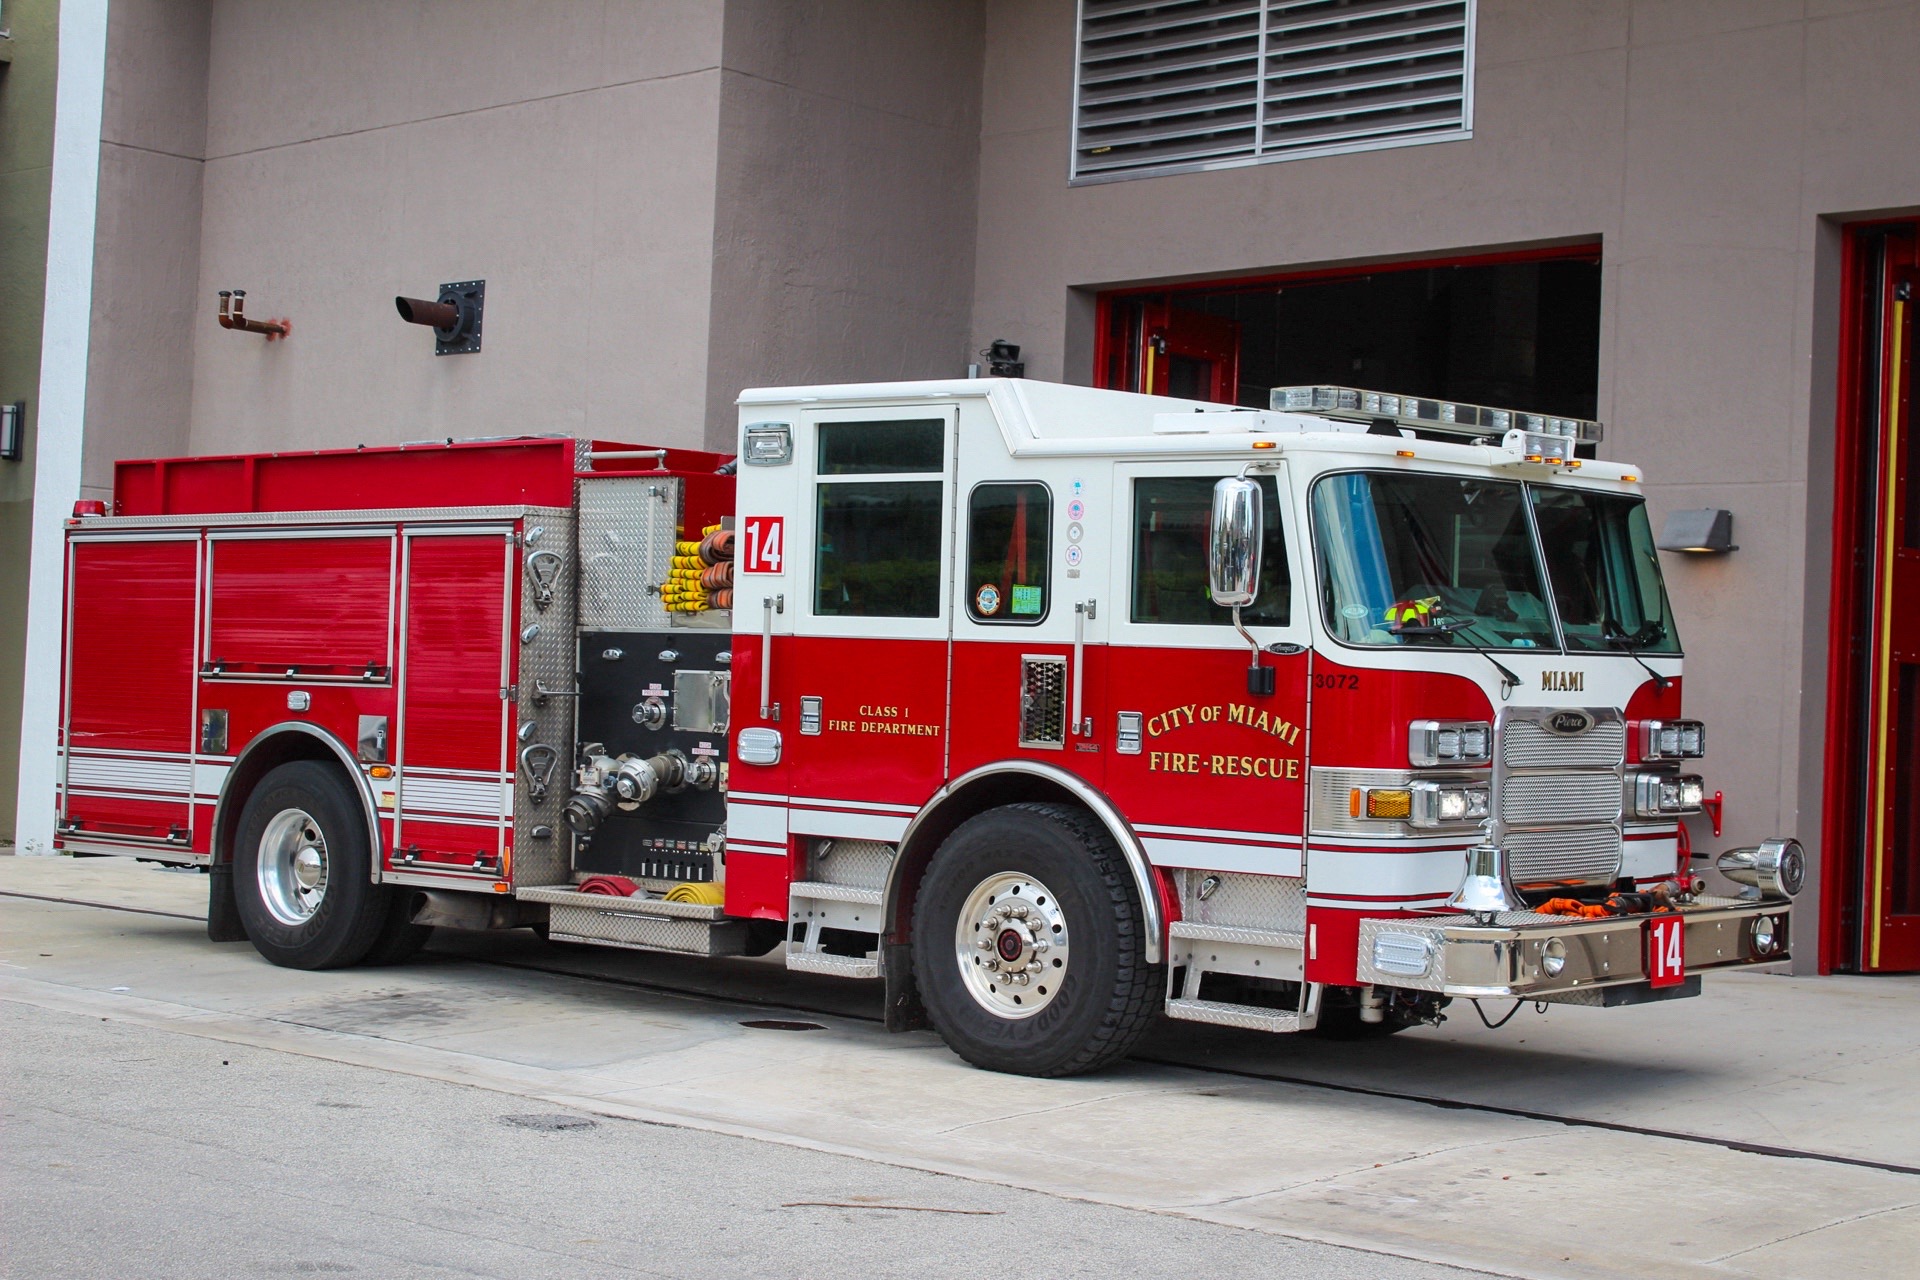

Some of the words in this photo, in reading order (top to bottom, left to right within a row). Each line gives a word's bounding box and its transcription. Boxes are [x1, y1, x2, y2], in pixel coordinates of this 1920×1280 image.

[746, 521, 781, 571] 14
[1315, 674, 1360, 690] 3072
[1541, 670, 1584, 692] MIAMI
[859, 705, 898, 717] CLASS
[828, 720, 856, 732] FIRE
[861, 721, 940, 737] DEPARTMENT
[1147, 703, 1197, 738] CITY
[1200, 705, 1222, 723] OF
[1228, 702, 1301, 747] MIAMI
[1653, 921, 1682, 978] 14
